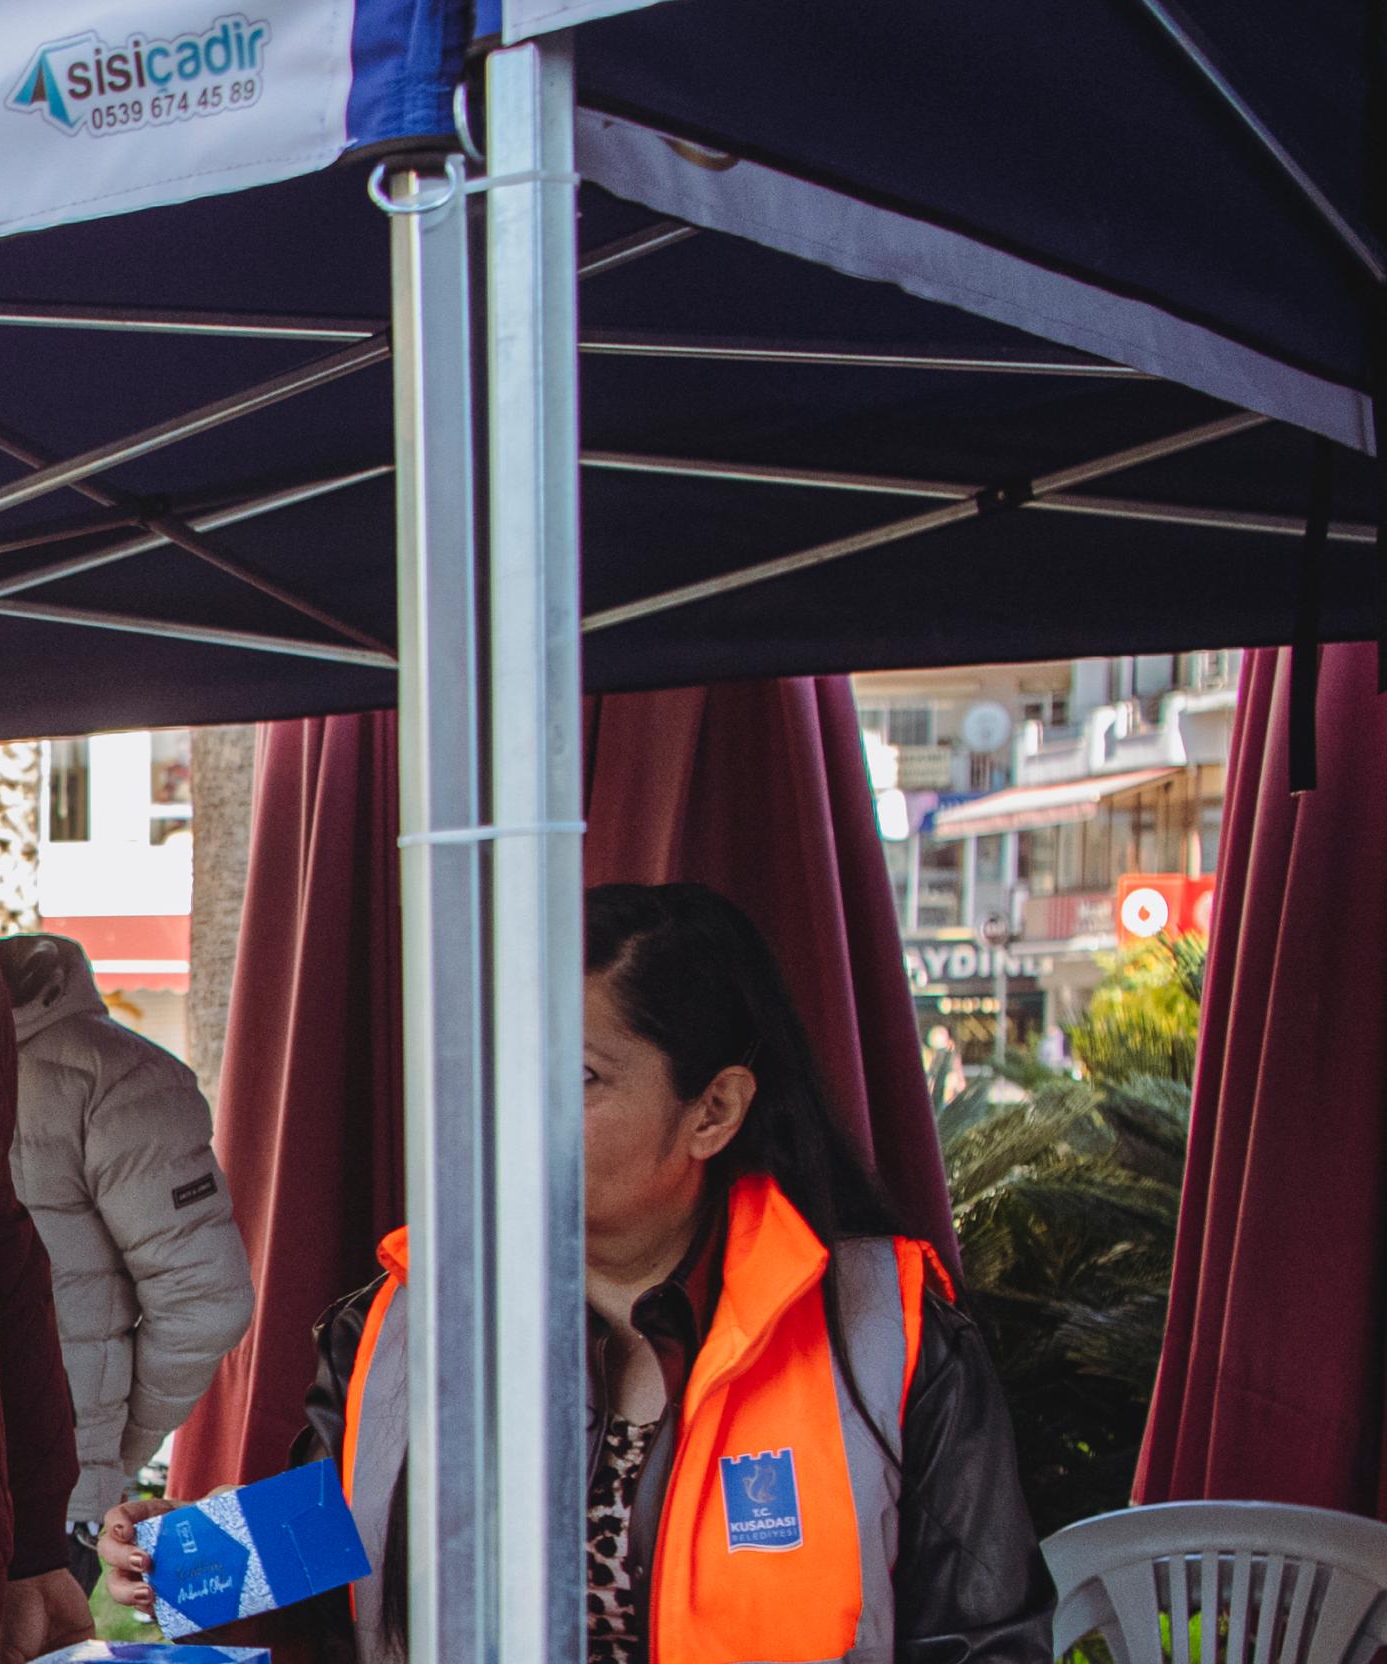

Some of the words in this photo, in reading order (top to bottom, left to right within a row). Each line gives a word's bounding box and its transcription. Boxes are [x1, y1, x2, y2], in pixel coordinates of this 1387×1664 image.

[91, 102, 144, 130] 0539
[150, 92, 190, 119] 674
[196, 85, 223, 110] 45
[229, 78, 256, 104] 89
